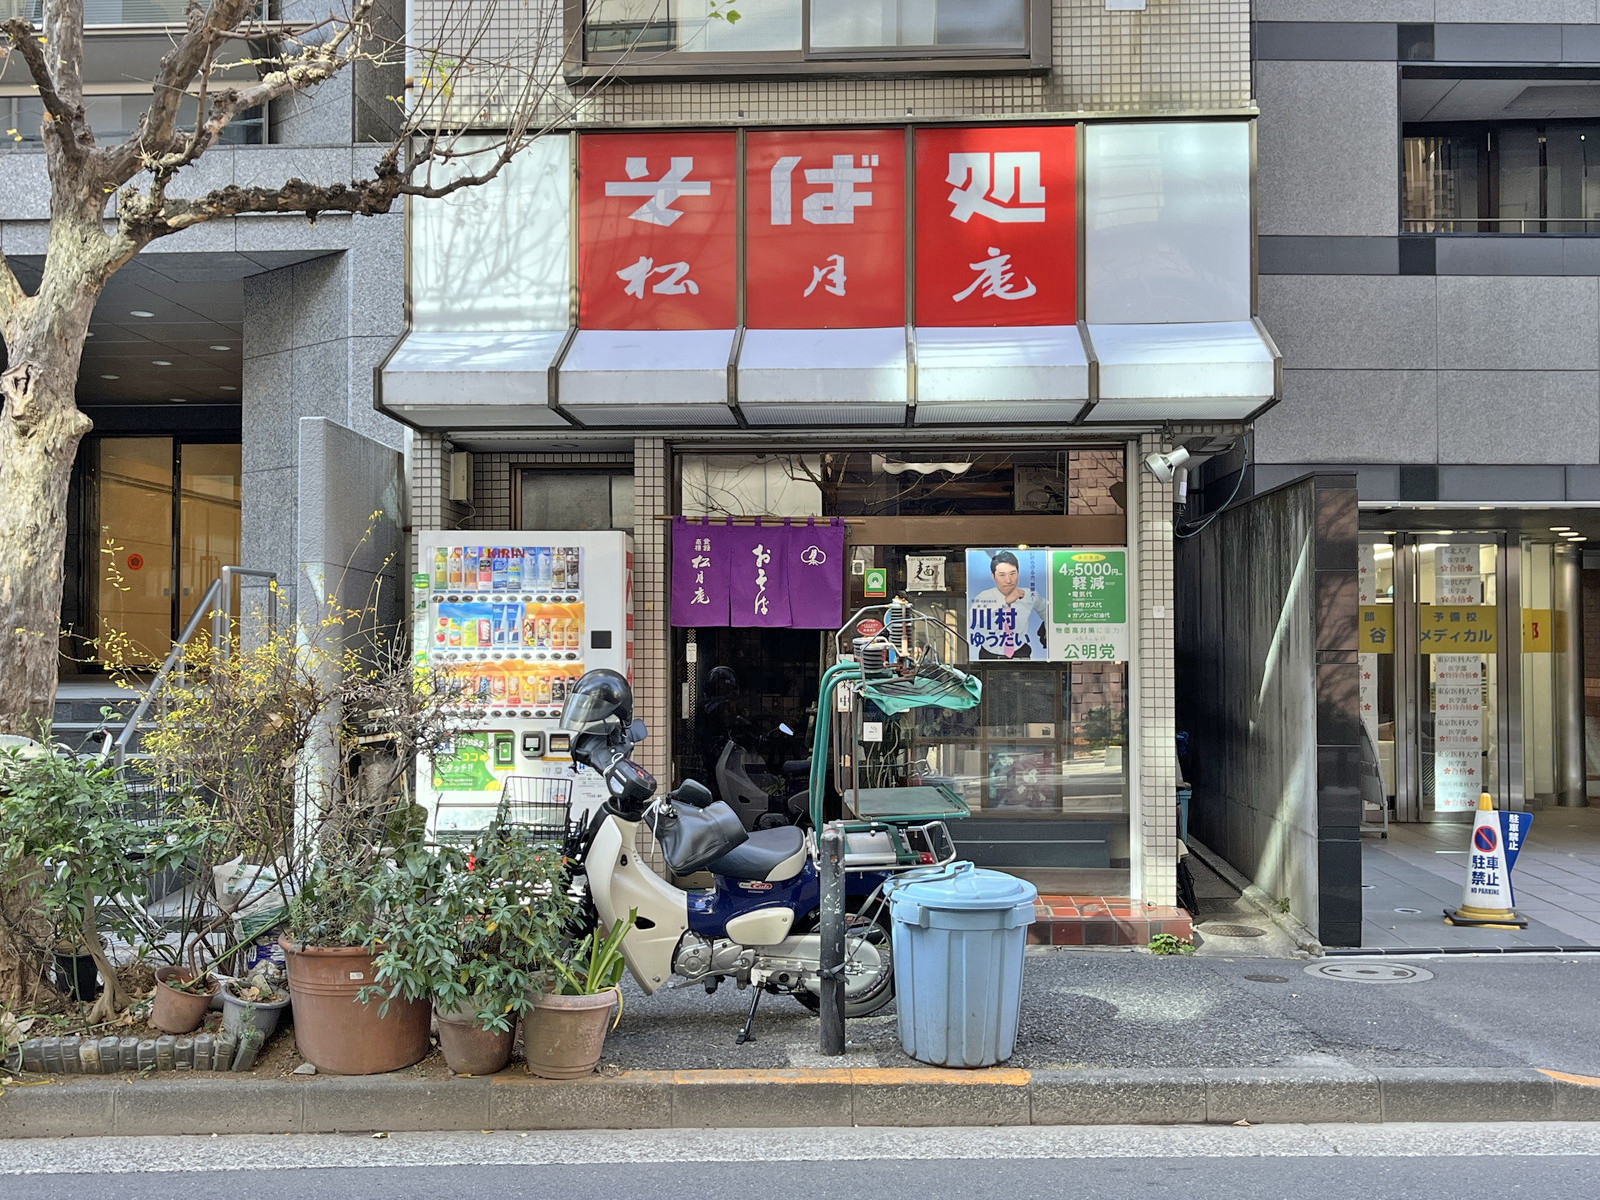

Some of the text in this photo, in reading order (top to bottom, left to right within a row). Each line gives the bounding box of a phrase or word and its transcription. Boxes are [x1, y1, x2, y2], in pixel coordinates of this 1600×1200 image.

[605, 151, 1046, 227] そば処
[616, 246, 1037, 302] 松月庵
[487, 547, 525, 558] KIRIN
[1058, 563, 1119, 576] 4万5000円
[690, 554, 711, 605] 松月庵
[1072, 576, 1105, 590] 軽減
[1072, 590, 1093, 598] 電気代
[970, 608, 1018, 630] 川村
[1434, 611, 1477, 622] 予備校
[970, 631, 1031, 648] ゆうだい
[1369, 627, 1493, 644] 谷 メディカル
[1064, 643, 1115, 659] 公明党
[1508, 813, 1520, 851] 駐車禁止
[1472, 855, 1500, 870] 駐車
[1471, 871, 1500, 887] 禁止
[1478, 887, 1500, 896] PARKING
